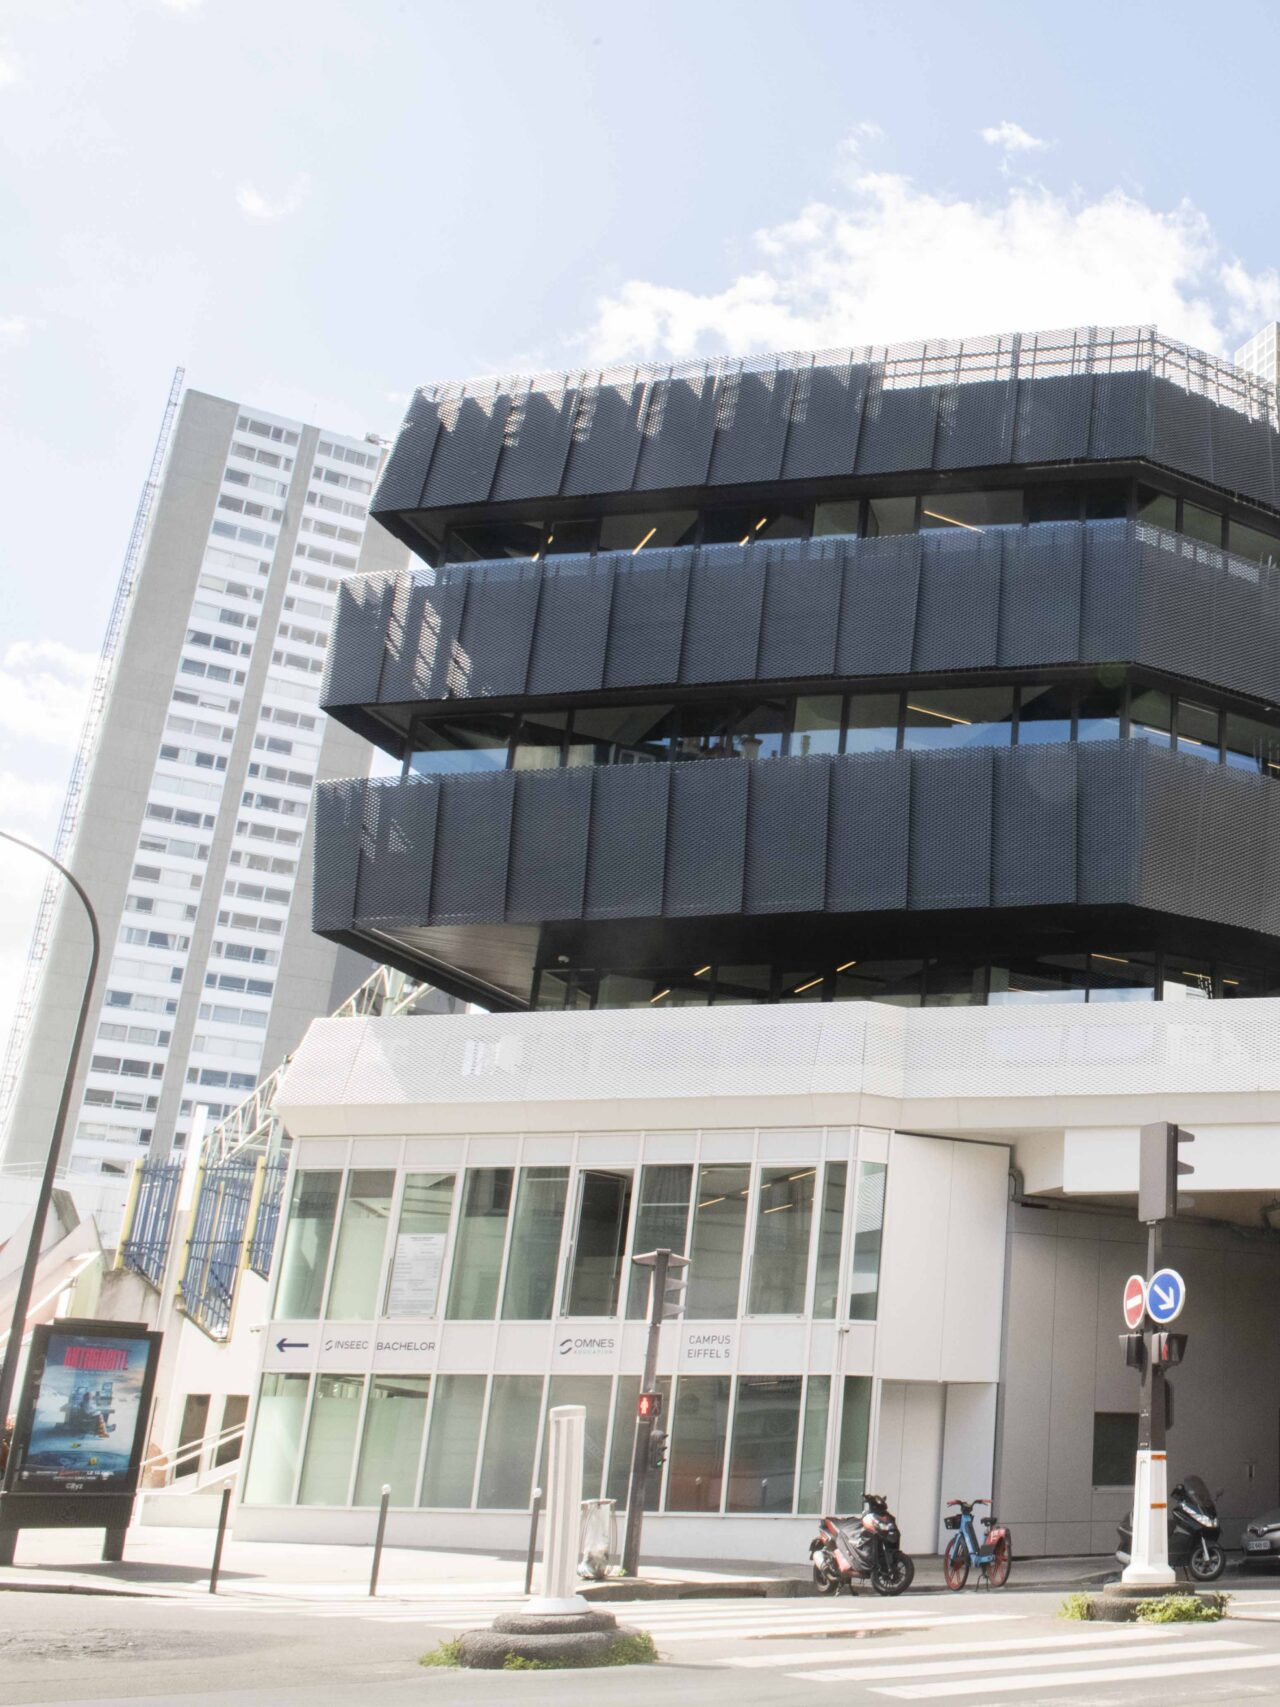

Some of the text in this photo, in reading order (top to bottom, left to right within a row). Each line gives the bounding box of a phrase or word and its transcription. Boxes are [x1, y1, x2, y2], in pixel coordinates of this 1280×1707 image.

[574, 1338, 615, 1349] OMNES
[688, 1335, 731, 1345] CAMPUS
[334, 1340, 436, 1352] INSEEC BACHELOR
[687, 1348, 730, 1359] EIFFEL 5
